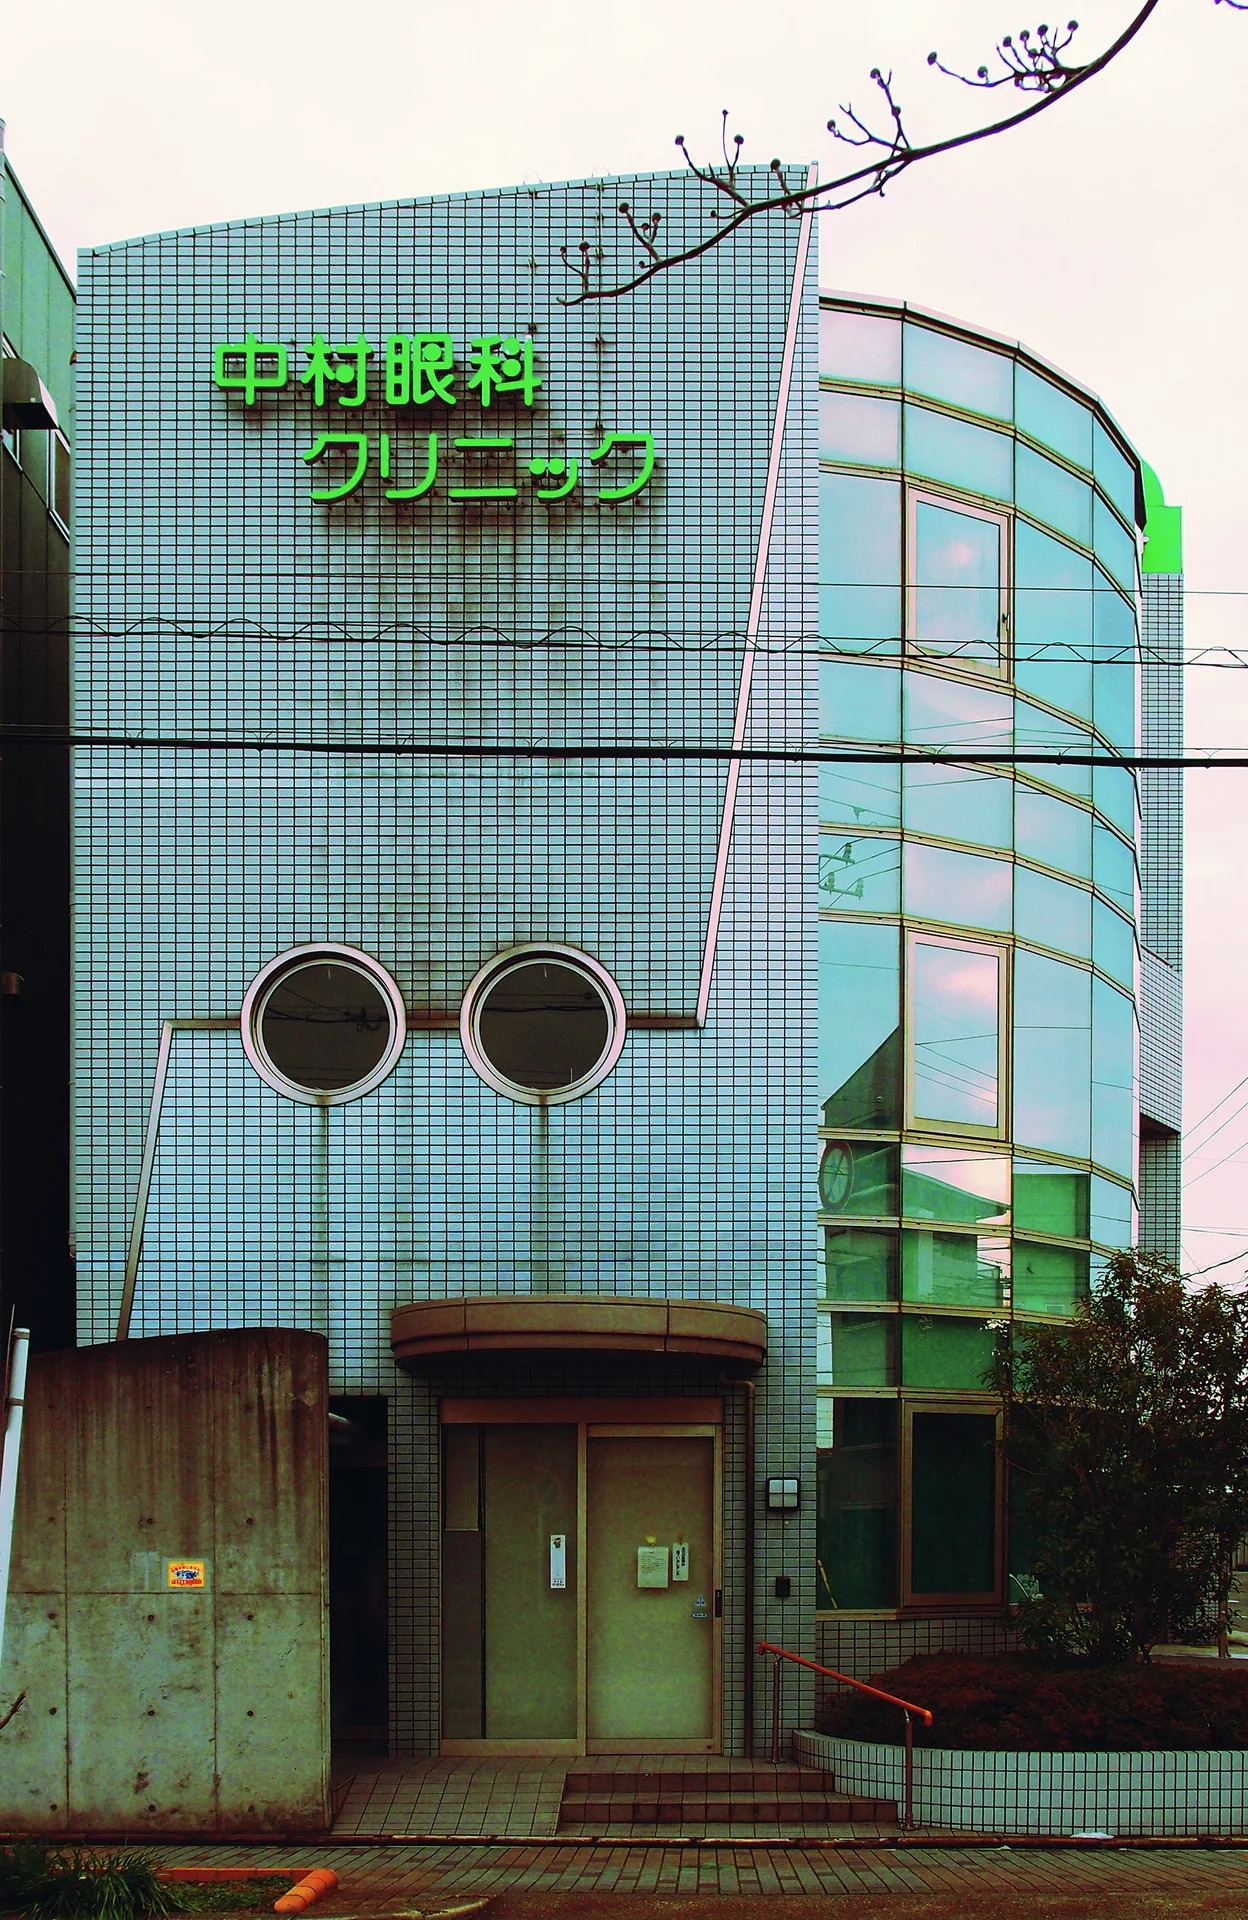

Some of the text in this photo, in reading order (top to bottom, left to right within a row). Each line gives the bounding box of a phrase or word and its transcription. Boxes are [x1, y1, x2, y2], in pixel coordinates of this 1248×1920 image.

[214, 332, 542, 407] 中村眼科
[302, 432, 656, 501] クリニック
